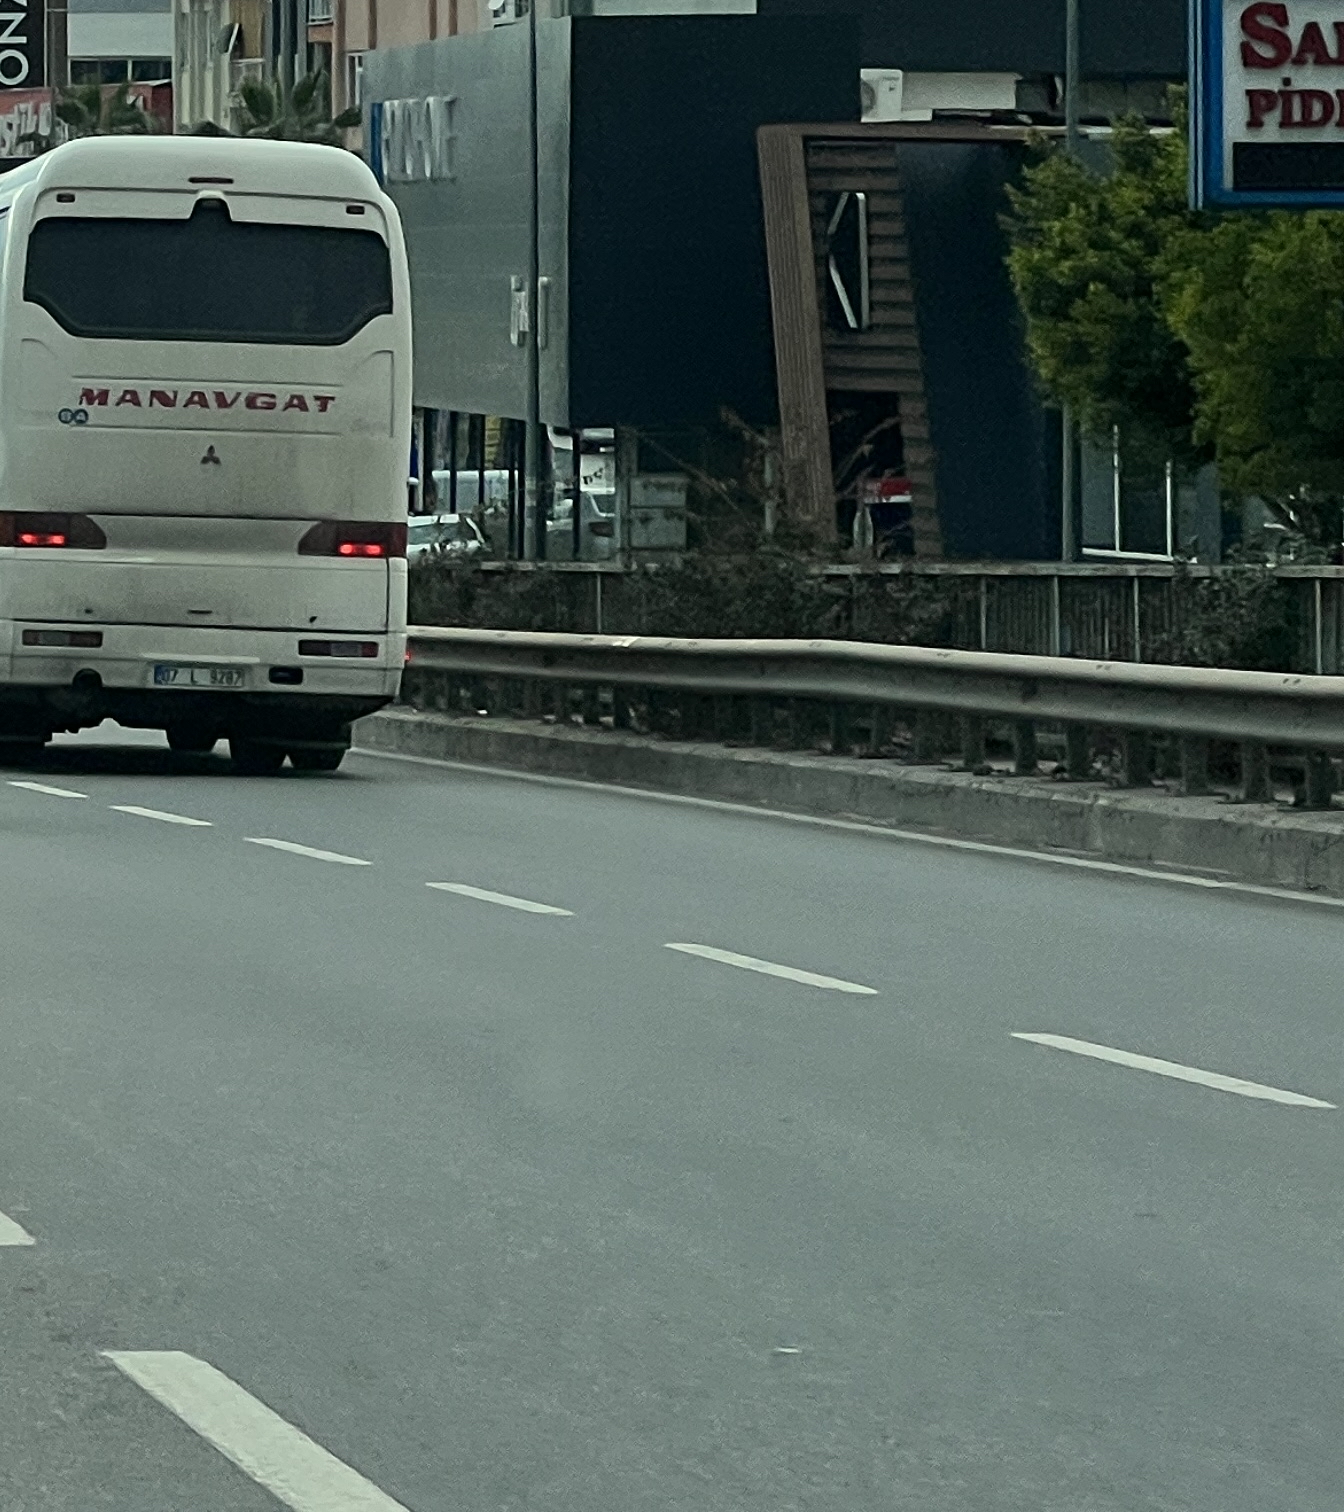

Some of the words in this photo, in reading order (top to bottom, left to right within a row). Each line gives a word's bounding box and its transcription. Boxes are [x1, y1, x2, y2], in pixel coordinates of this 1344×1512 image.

[1240, 2, 1344, 69] SA
[1245, 77, 1344, 129] PİD
[78, 387, 337, 413] MANAVGAT
